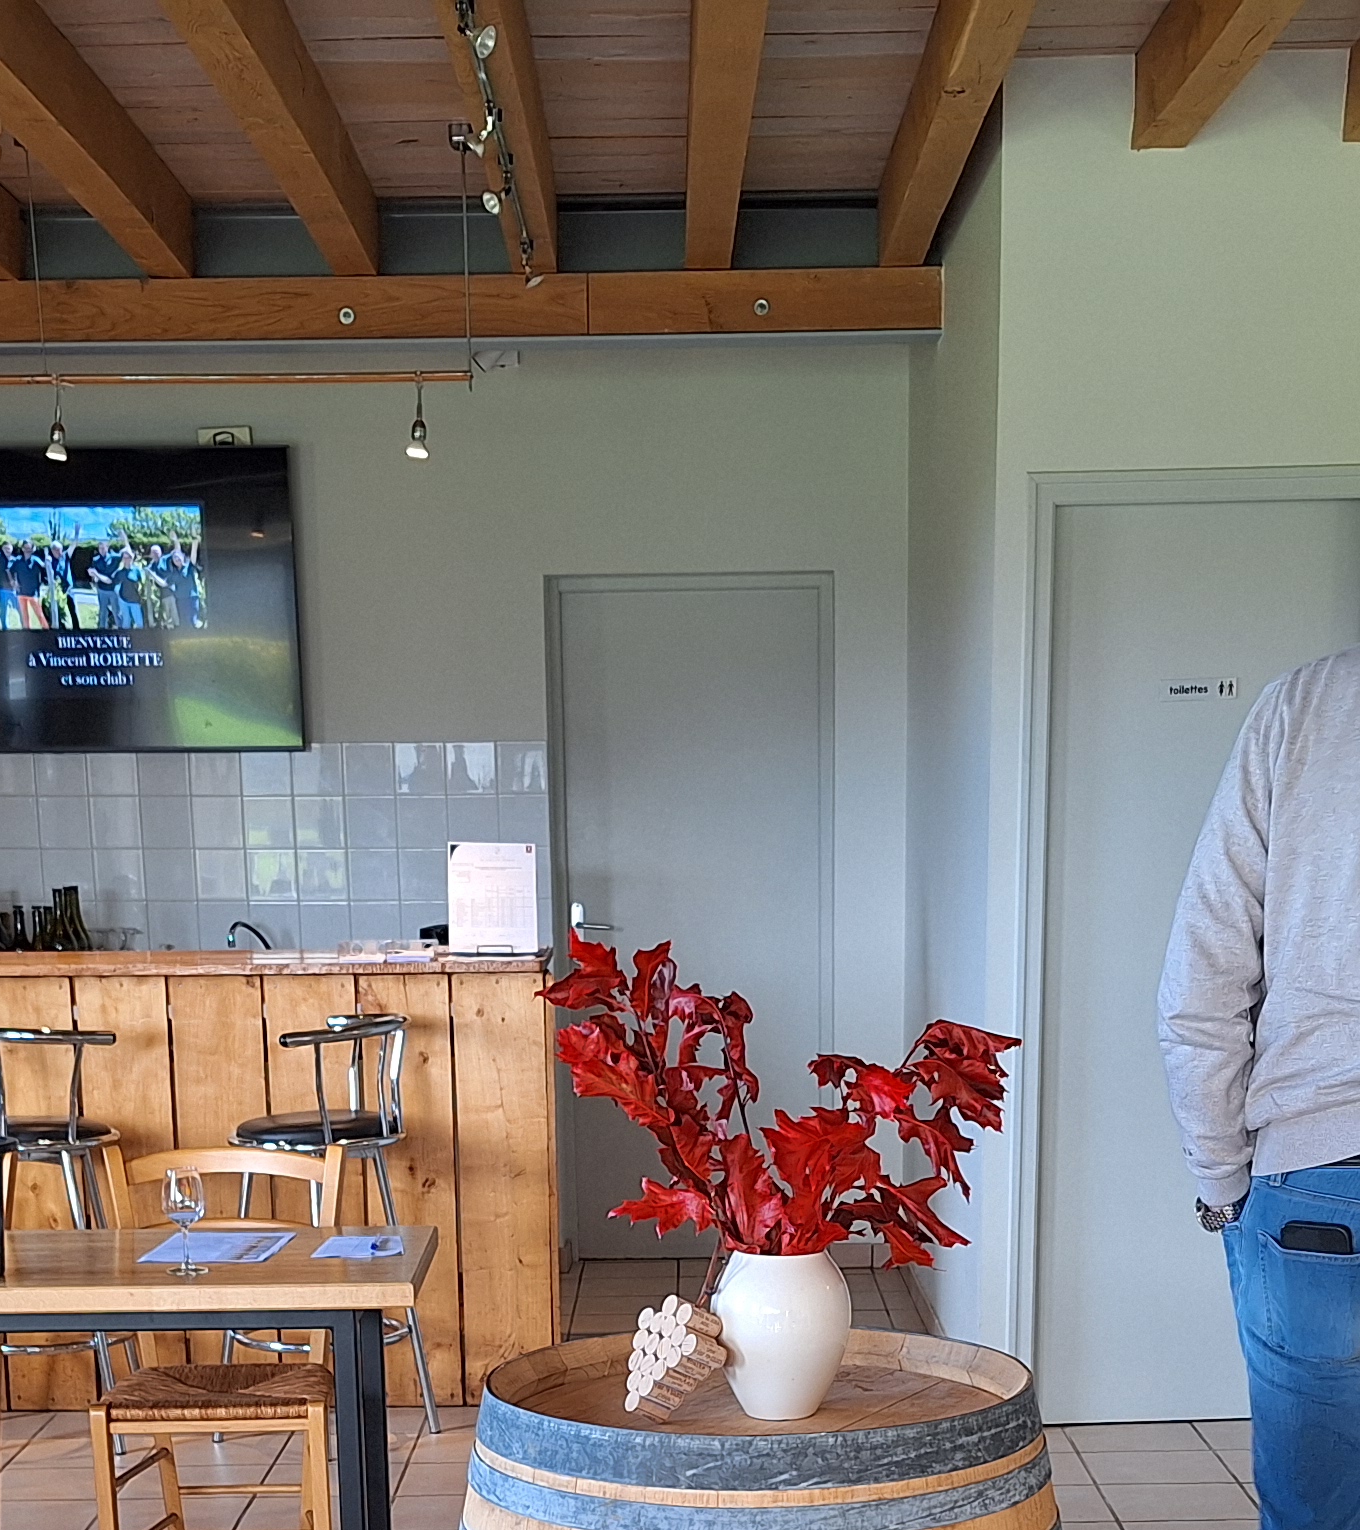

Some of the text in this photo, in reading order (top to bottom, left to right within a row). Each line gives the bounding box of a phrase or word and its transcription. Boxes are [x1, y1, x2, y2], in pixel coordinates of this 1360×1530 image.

[57, 635, 132, 649] BIENVENUE
[28, 652, 164, 667] à Vincent ROBETTE
[61, 672, 73, 686] et
[75, 673, 98, 686] son
[100, 669, 127, 686] club
[1169, 685, 1209, 696] toilettes
